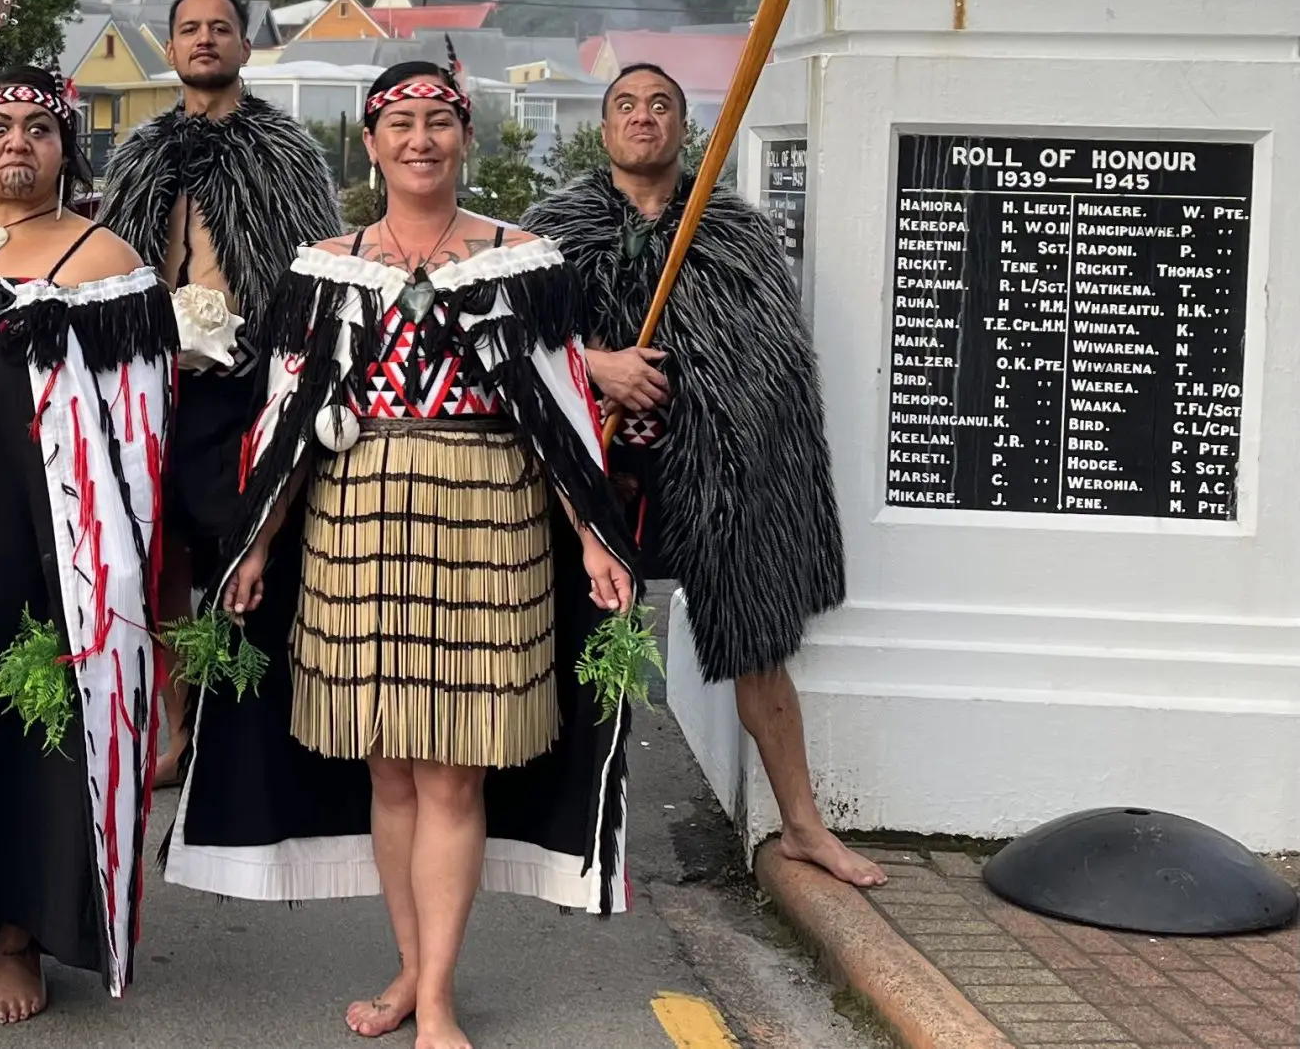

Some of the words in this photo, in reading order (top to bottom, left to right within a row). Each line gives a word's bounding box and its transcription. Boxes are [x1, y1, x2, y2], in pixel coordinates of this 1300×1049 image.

[953, 147, 1022, 169] ROLL
[1040, 149, 1075, 168] OF
[1092, 150, 1196, 171] HONOUR
